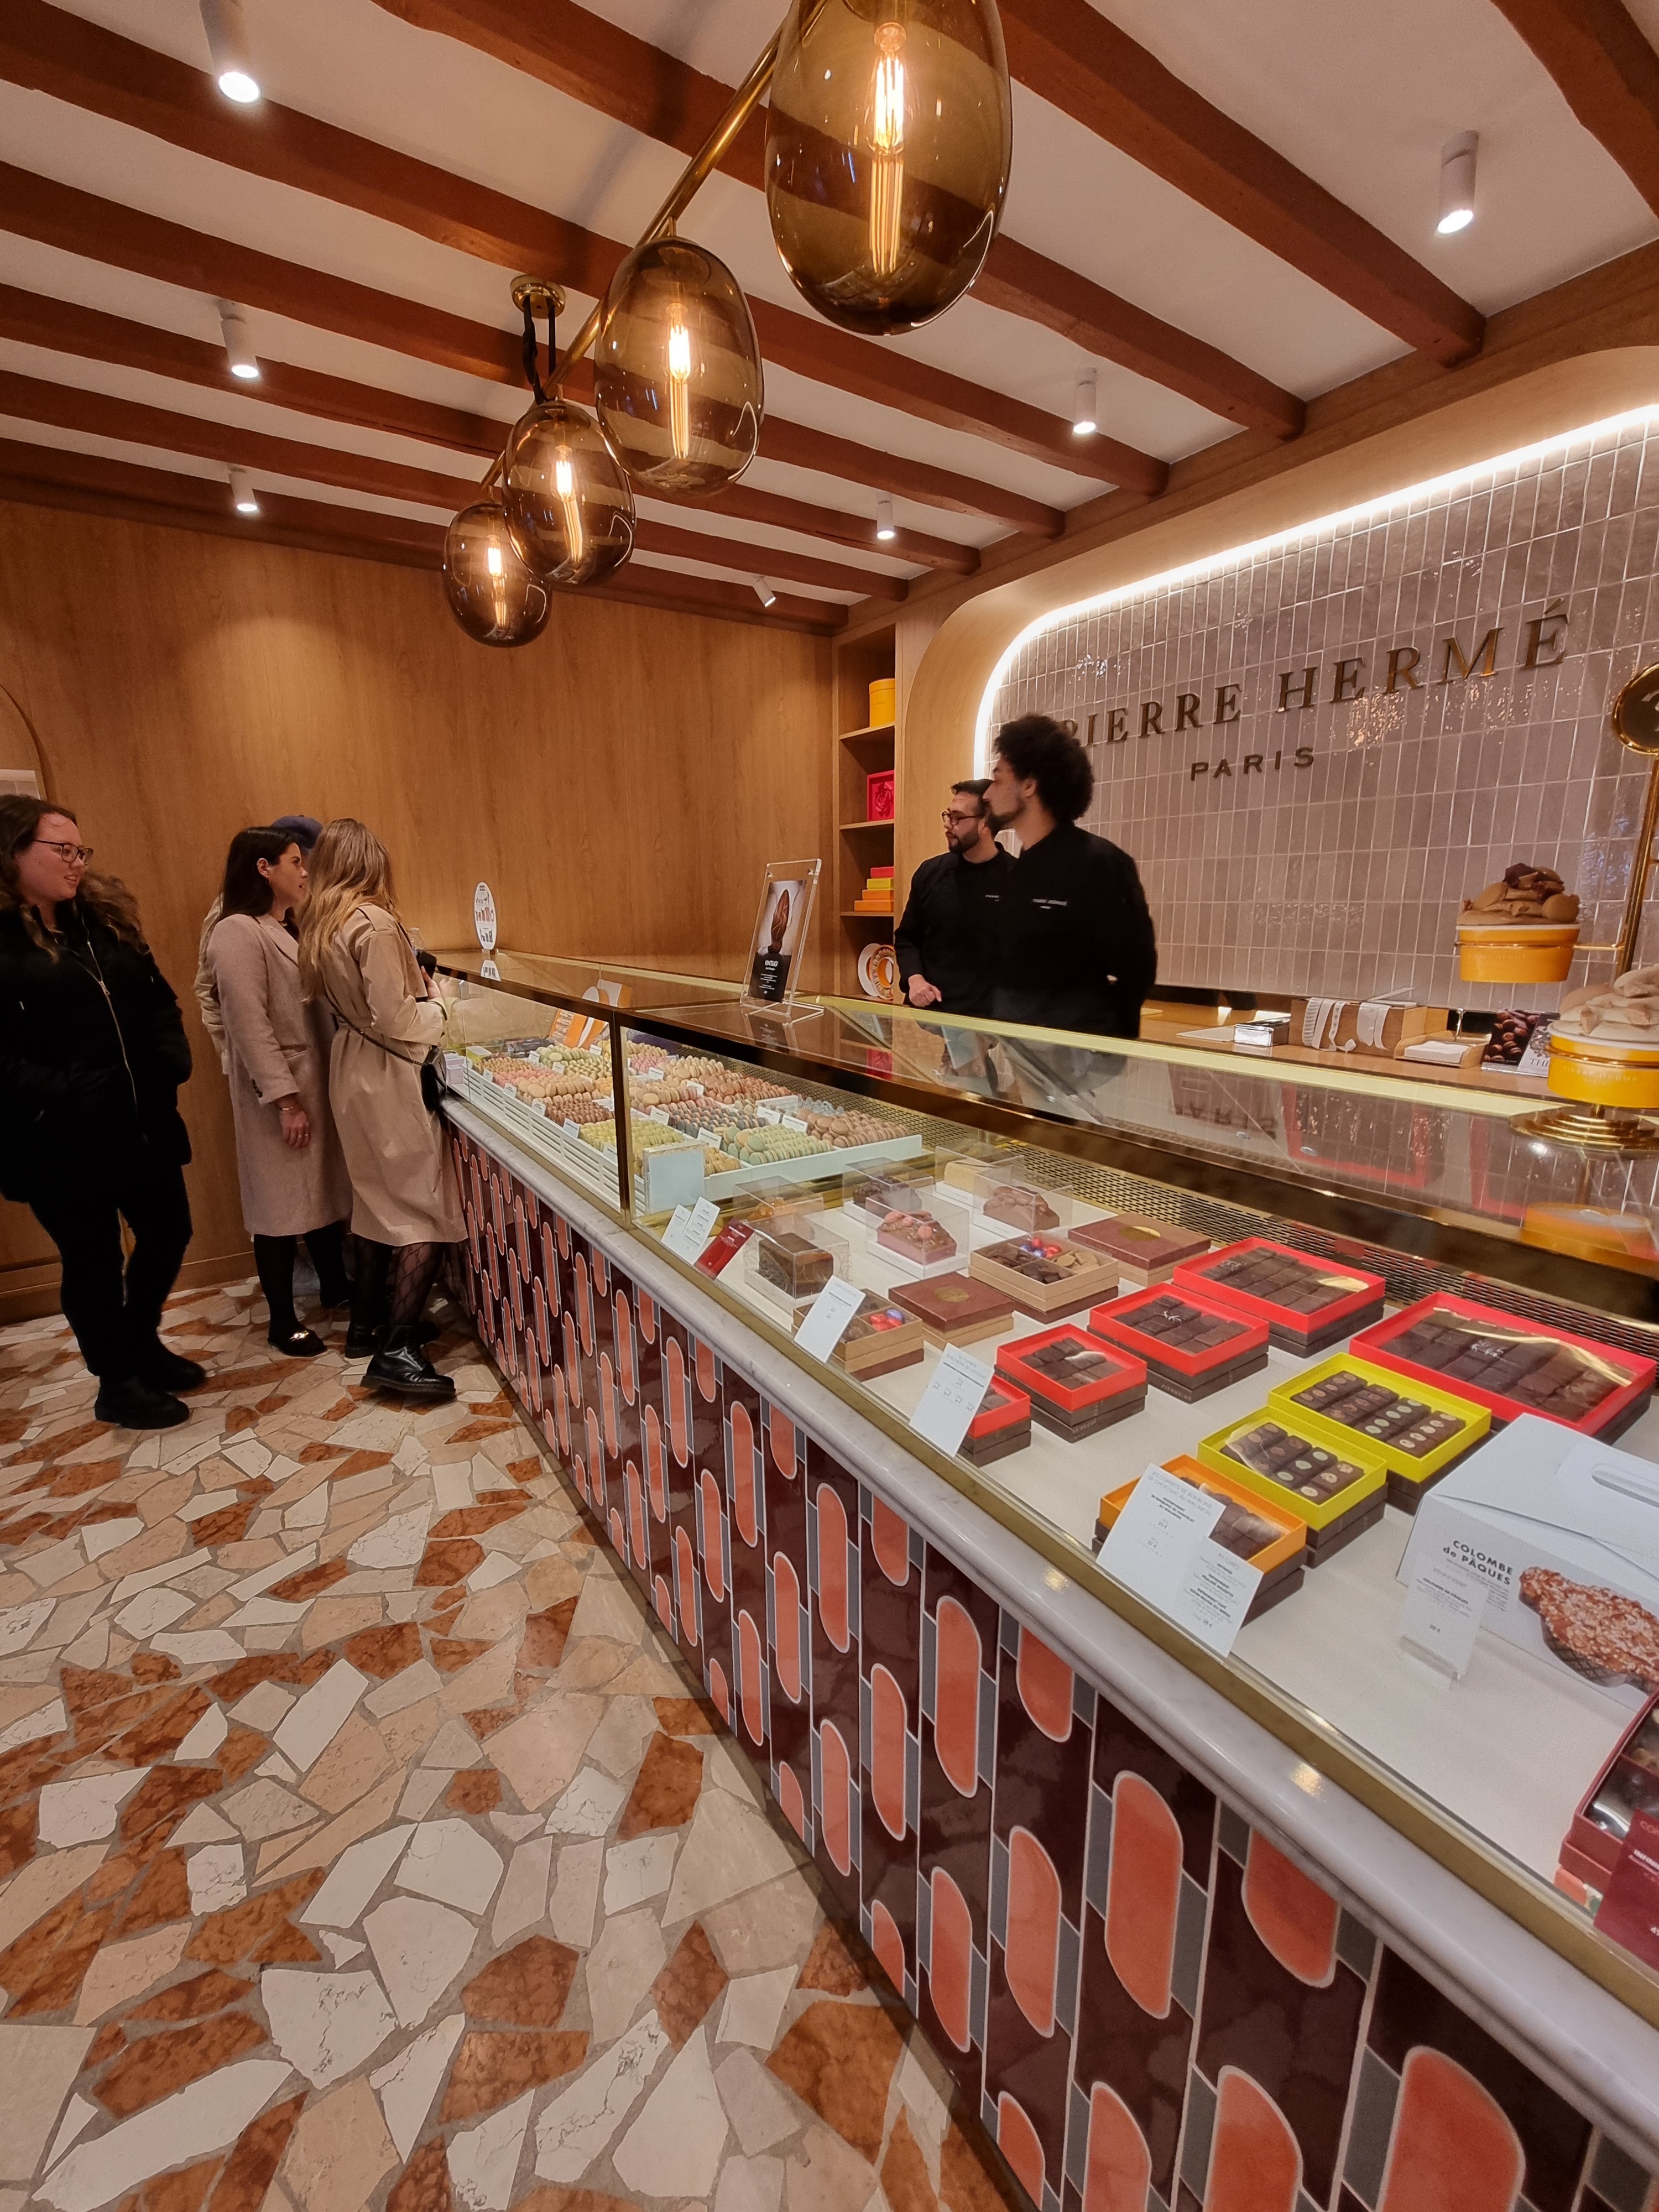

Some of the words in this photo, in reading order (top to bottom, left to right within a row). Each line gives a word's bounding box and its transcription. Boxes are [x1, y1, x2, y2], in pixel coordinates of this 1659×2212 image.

[1277, 598, 1569, 712] HERMÉ
[1191, 747, 1314, 780] PARIS
[1443, 1547, 1457, 1558] de
[1461, 1555, 1511, 1585] PÂQUES
[1453, 1540, 1514, 1575] COLOMBE
